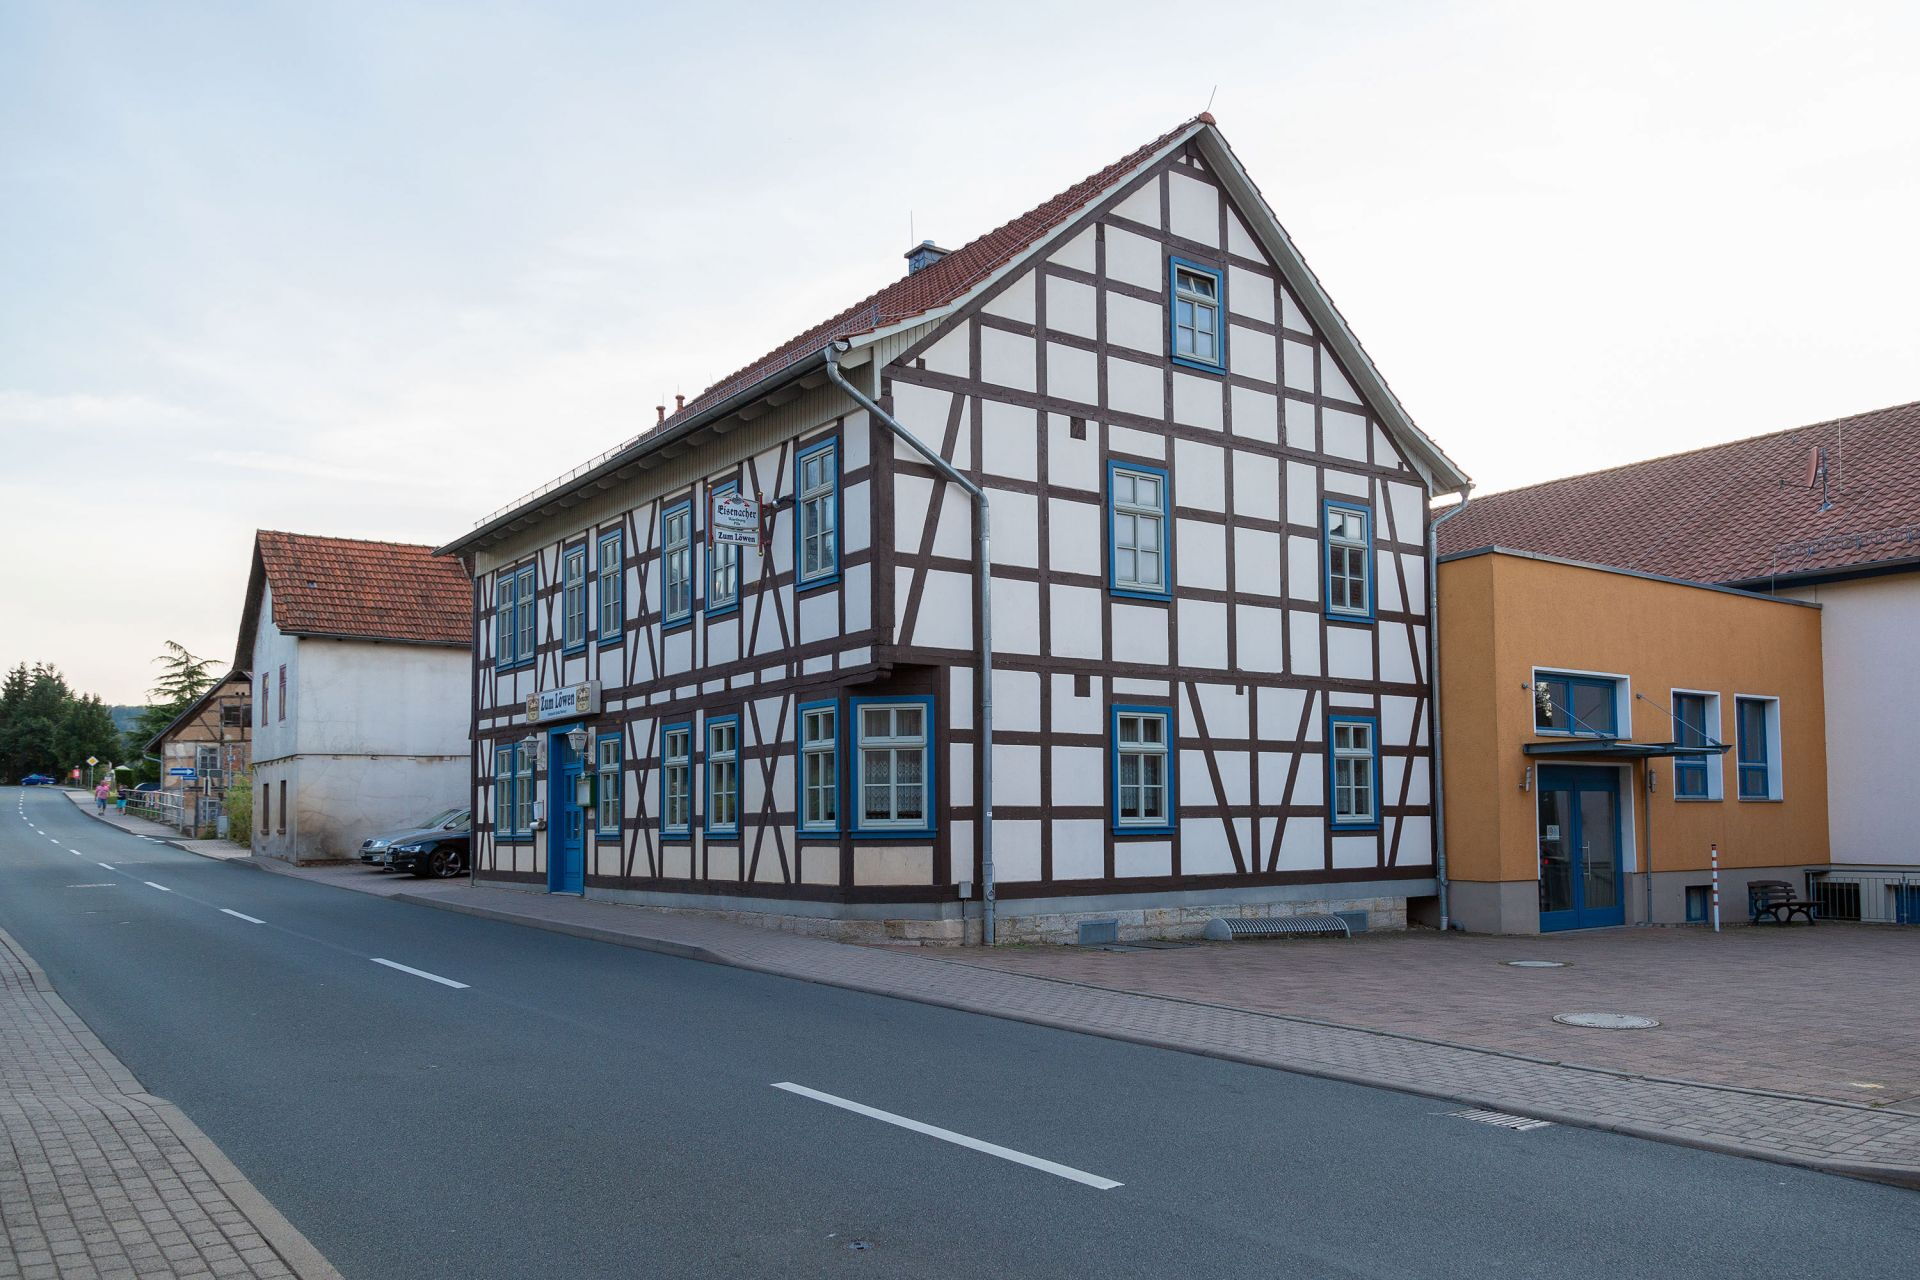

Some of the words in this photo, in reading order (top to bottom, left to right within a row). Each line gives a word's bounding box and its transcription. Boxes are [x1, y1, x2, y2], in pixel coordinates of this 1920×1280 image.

[718, 505, 756, 519] Eisenacher
[718, 532, 733, 540] Zum
[735, 533, 755, 542] Löwen
[541, 696, 553, 711] Zum
[555, 691, 574, 708] Löwen
